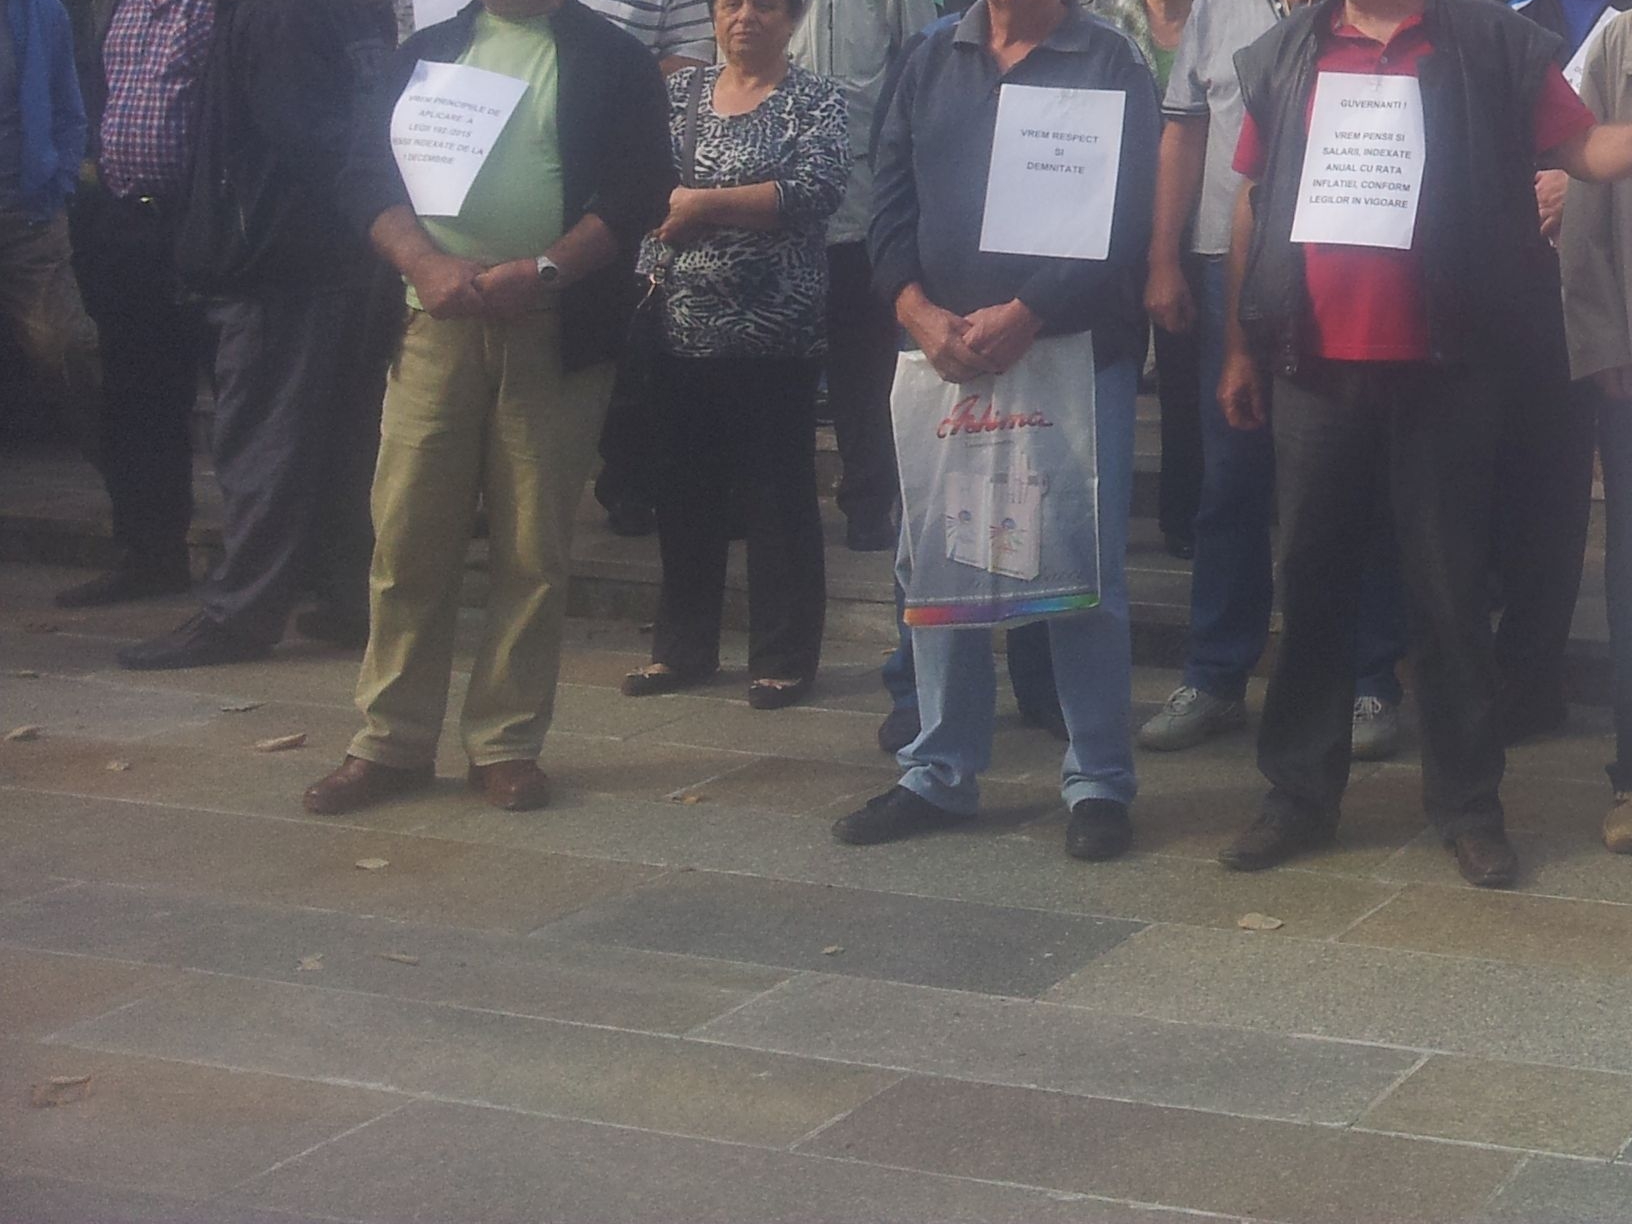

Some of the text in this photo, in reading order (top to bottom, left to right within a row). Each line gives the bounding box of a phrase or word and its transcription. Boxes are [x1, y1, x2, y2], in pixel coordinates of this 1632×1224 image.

[1020, 129, 1098, 144] VREM RESPECT
[1334, 131, 1405, 142] VREM PENSII SI
[471, 147, 484, 156] LA
[1054, 148, 1064, 156] SI
[1363, 148, 1412, 159] INDEXATE
[1027, 161, 1085, 174] DEMNITATE
[1326, 163, 1402, 174] ANUAL CU RATA
[1360, 180, 1411, 192] CONFORM
[1309, 196, 1408, 208] LEGILOR IN VIGOARE
